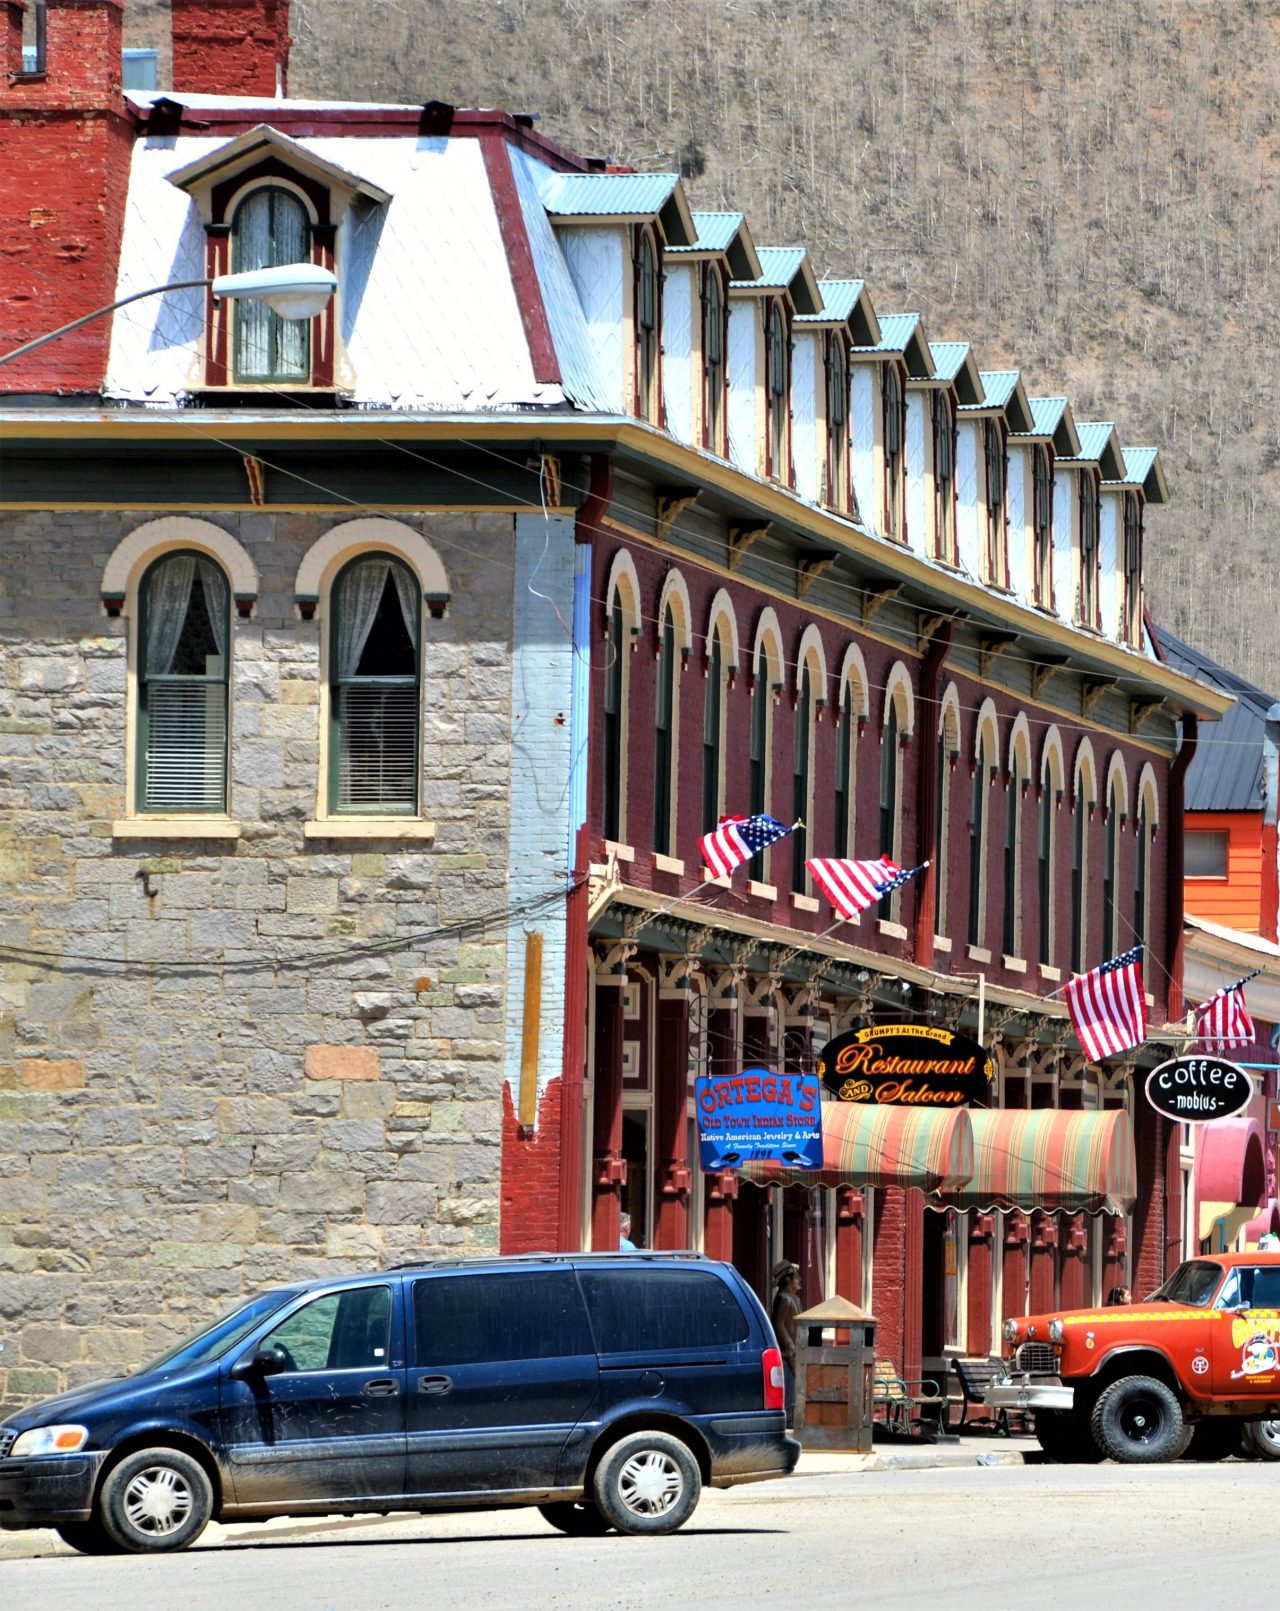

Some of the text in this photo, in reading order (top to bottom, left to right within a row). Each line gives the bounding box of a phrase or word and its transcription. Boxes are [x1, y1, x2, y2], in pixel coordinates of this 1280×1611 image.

[864, 1027, 900, 1038] GRUMPY'S
[925, 1028, 947, 1040] Grand
[835, 1043, 976, 1075] Restaurant
[1159, 1061, 1237, 1089] coffee
[700, 1077, 817, 1113] ORTEGA'S
[845, 1079, 965, 1104] AND Saloon
[703, 1113, 816, 1128] OLD TOWN INDIAN STORE
[701, 1131, 820, 1142] Native American Jewelry & Arts
